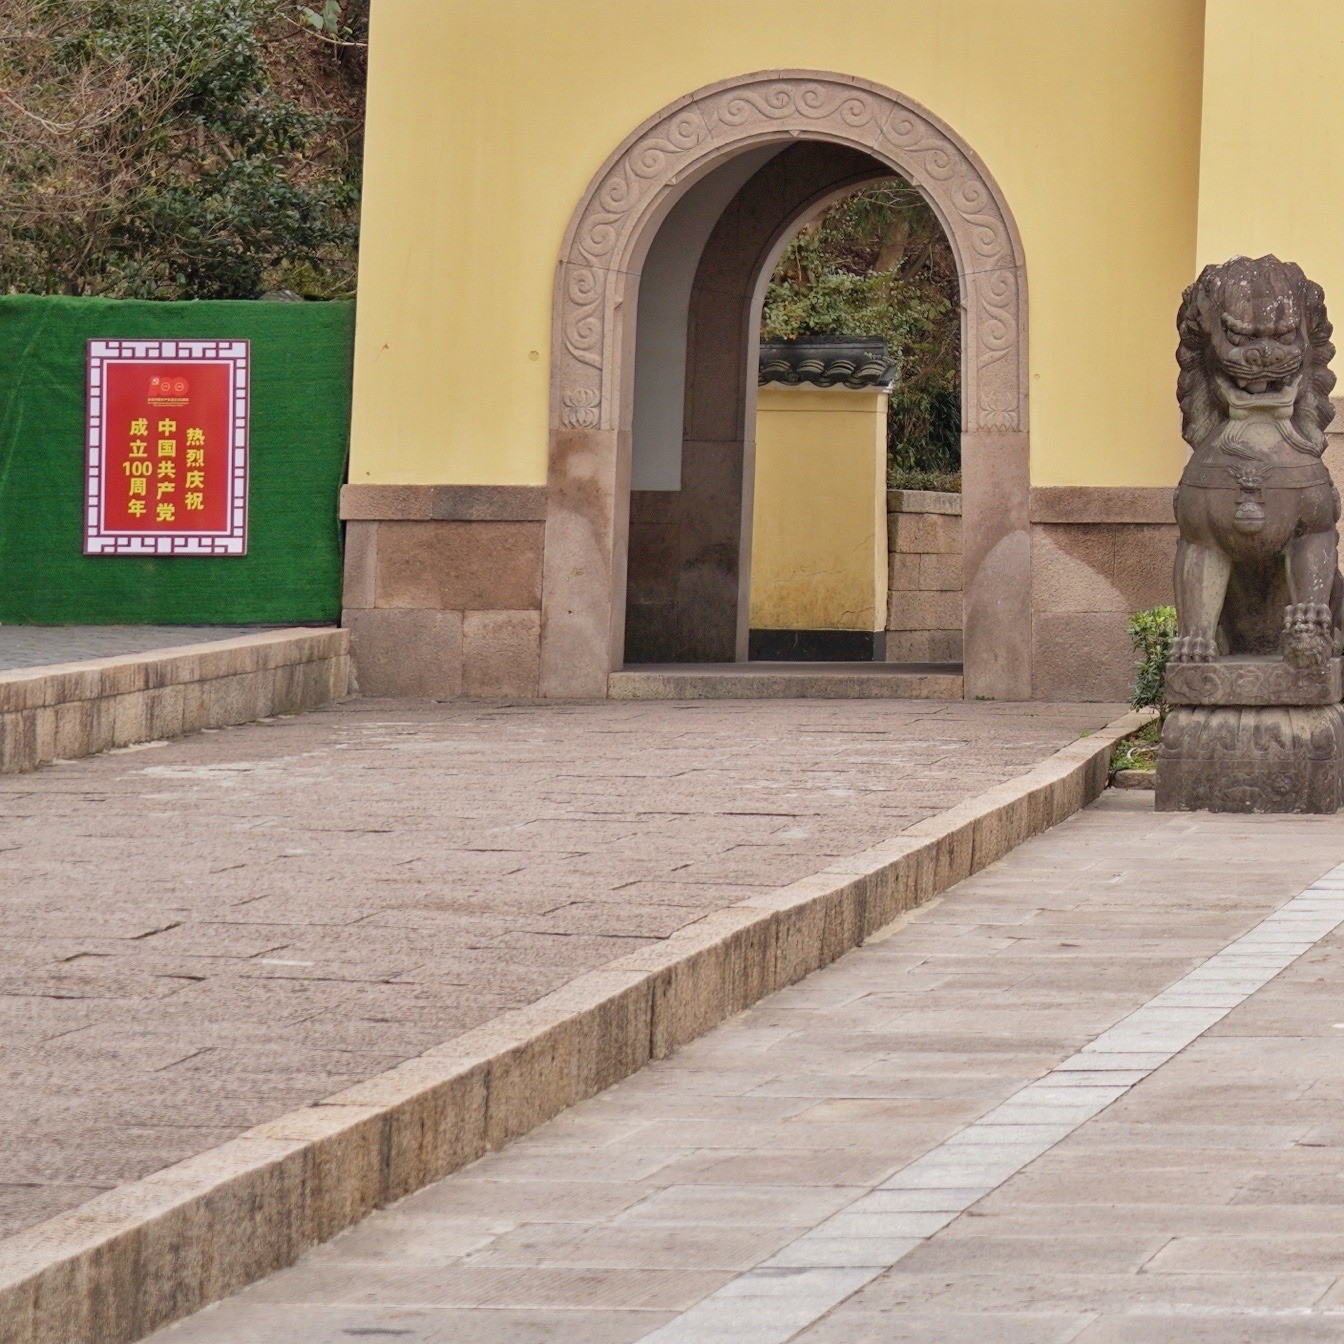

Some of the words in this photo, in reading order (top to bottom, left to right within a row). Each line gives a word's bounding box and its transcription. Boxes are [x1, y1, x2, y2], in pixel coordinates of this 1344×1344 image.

[122, 418, 152, 518] 成立100周年
[156, 418, 177, 522] 中国共产党
[185, 427, 205, 511] 热烈庆祝
